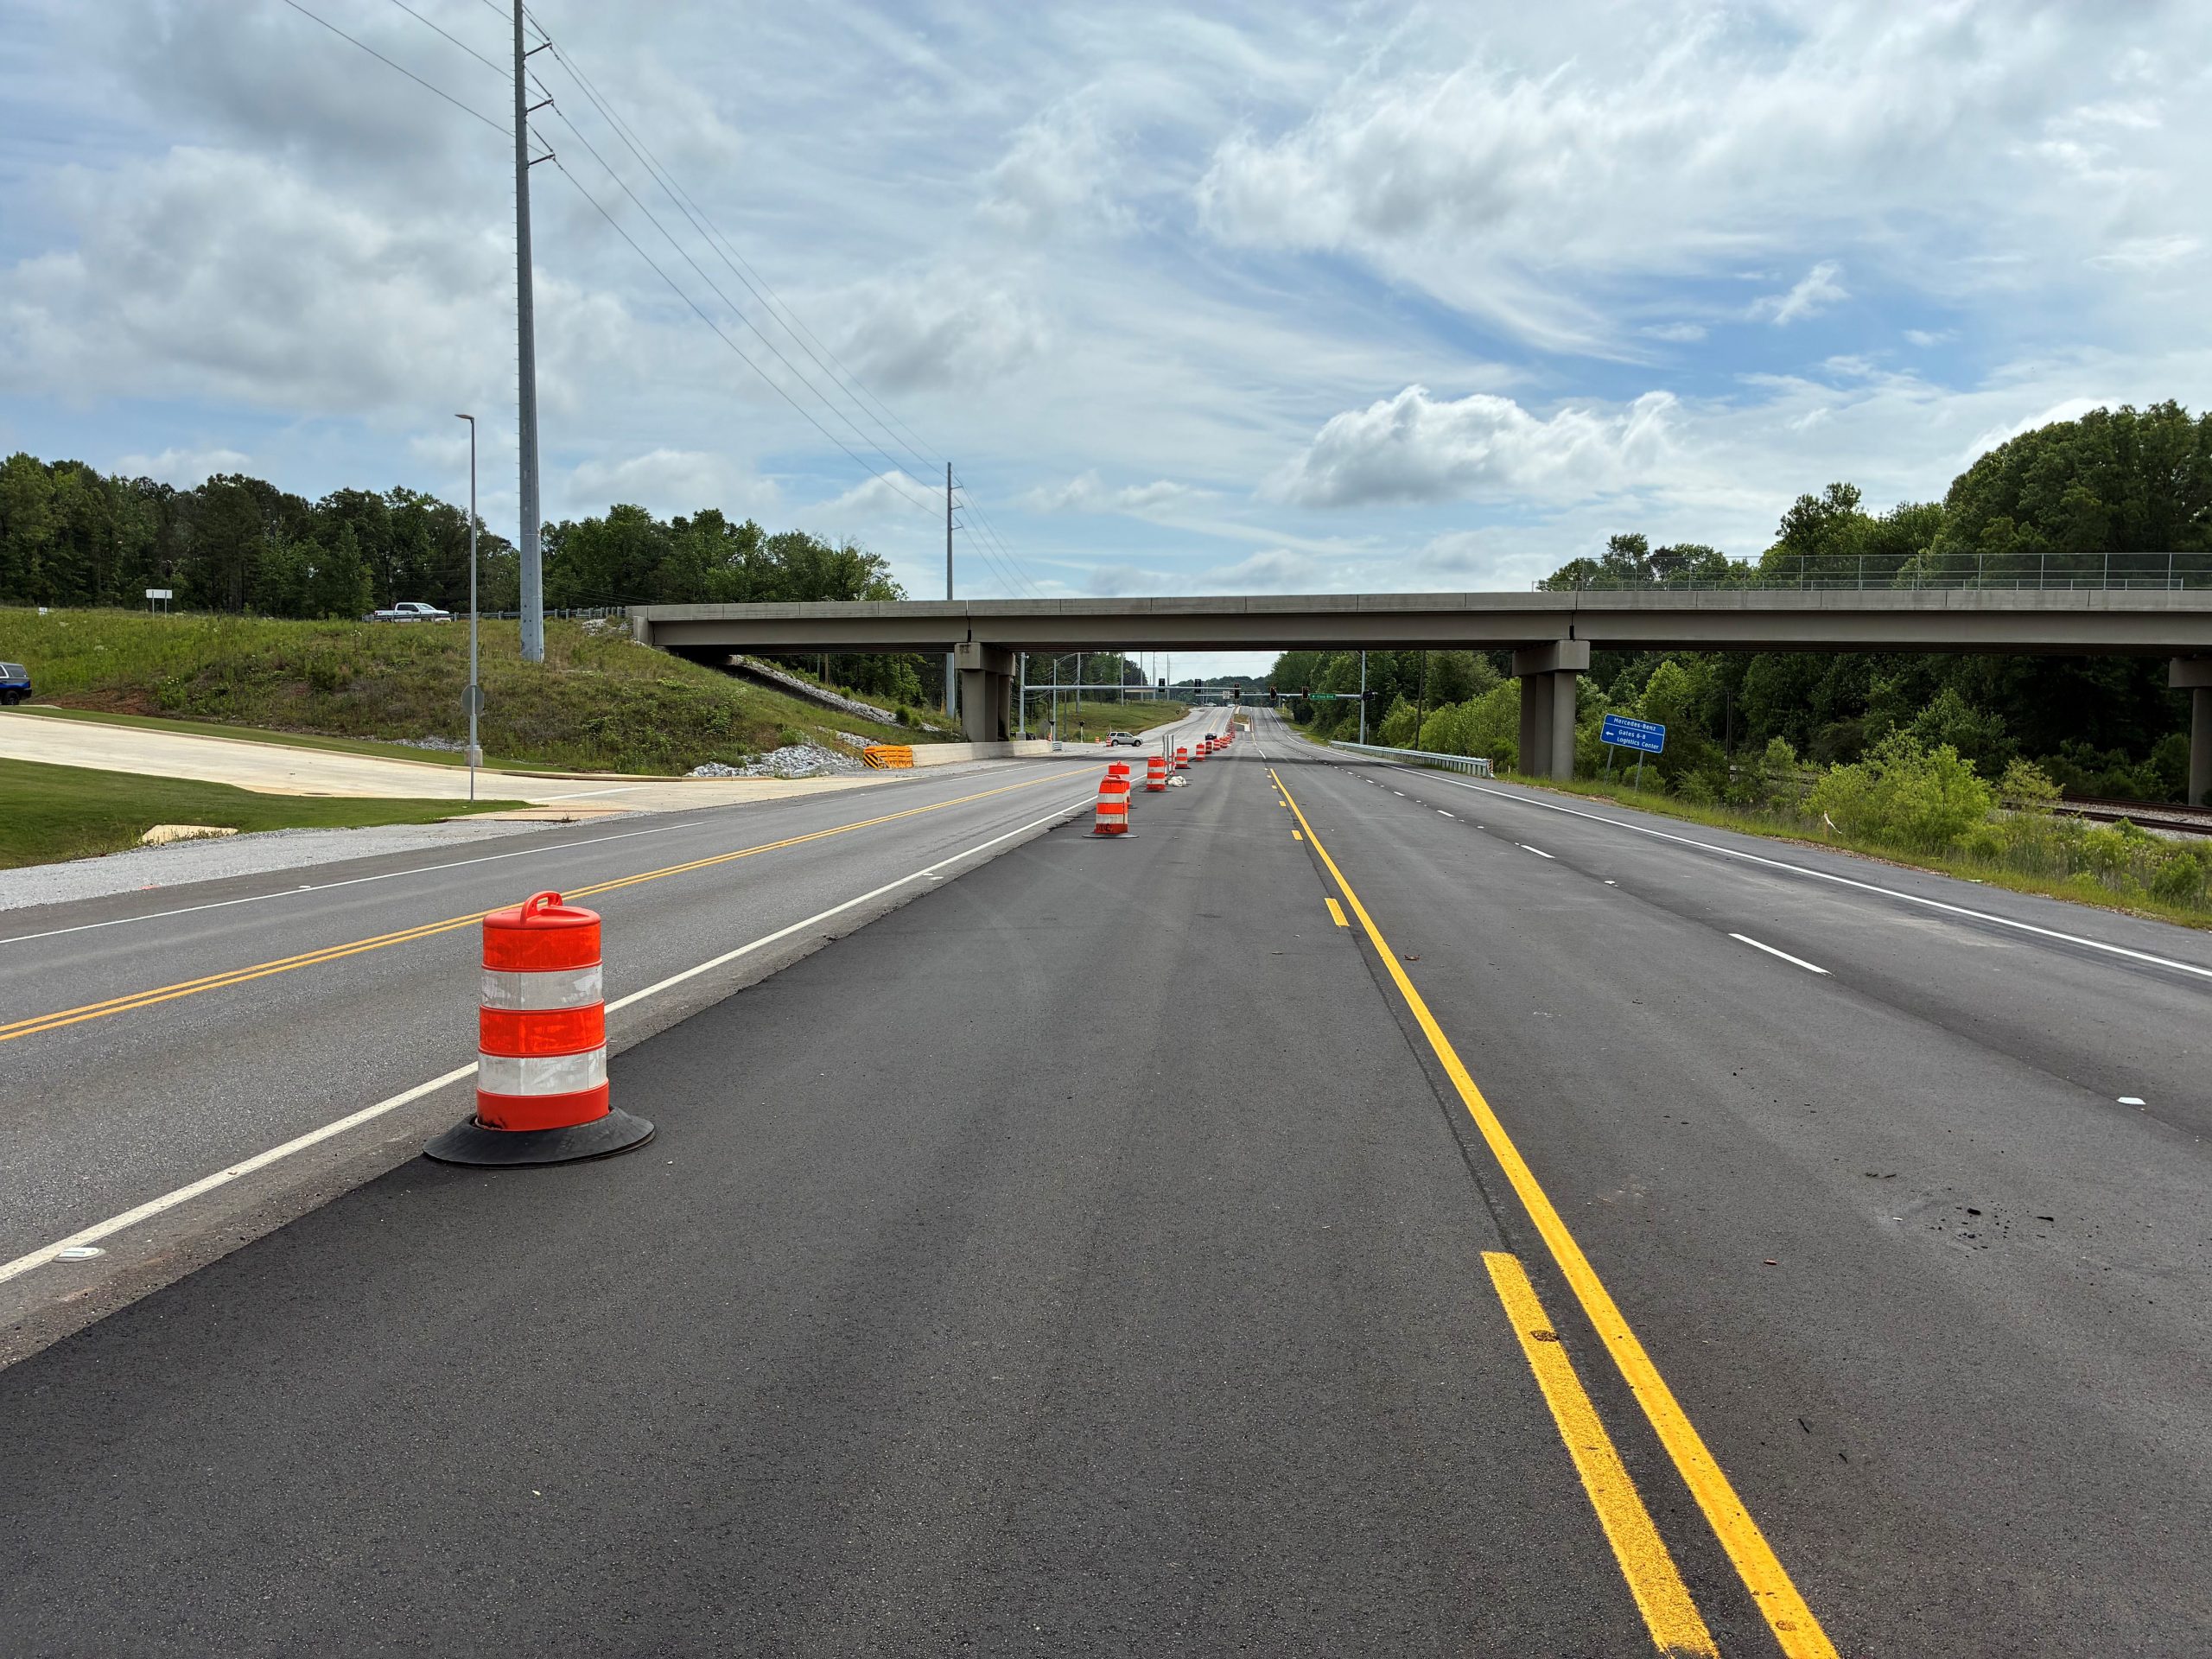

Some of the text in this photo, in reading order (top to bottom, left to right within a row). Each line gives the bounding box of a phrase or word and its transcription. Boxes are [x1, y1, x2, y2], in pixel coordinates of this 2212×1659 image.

[1613, 717, 1656, 731] Mercedes-Benz
[1618, 729, 1635, 738] Gates
[1617, 736, 1660, 750] Logistics Center
